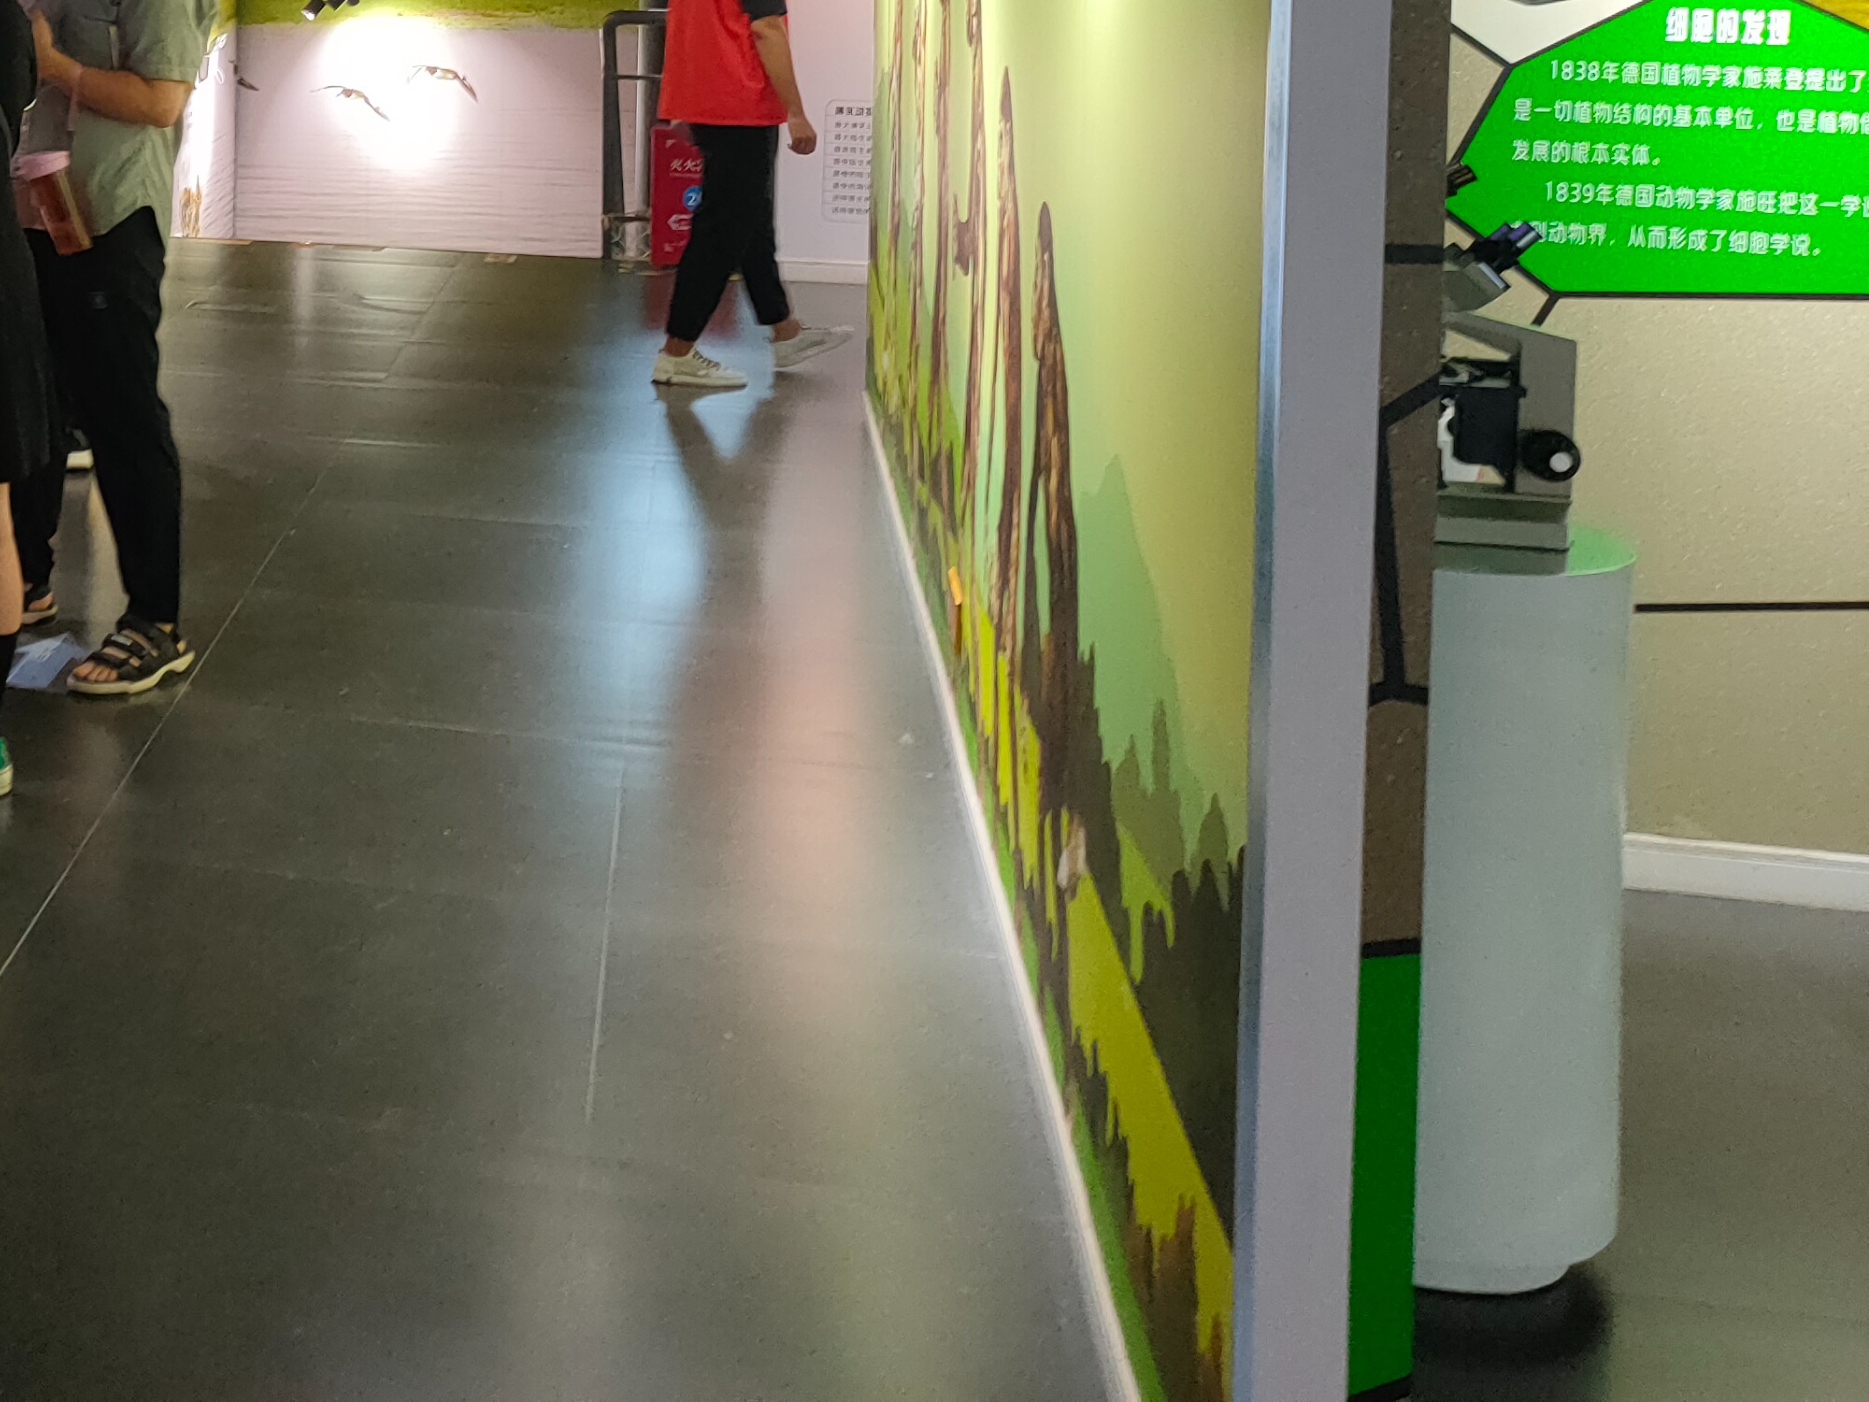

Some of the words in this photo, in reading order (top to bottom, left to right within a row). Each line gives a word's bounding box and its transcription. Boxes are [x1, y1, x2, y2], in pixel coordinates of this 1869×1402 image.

[1665, 6, 1791, 46] 细胞的发现
[1551, 58, 1869, 95] 1838年德国植物学家施莱登提出了
[1510, 220, 1822, 257] 到动物界，从而形成了细胞学说。
